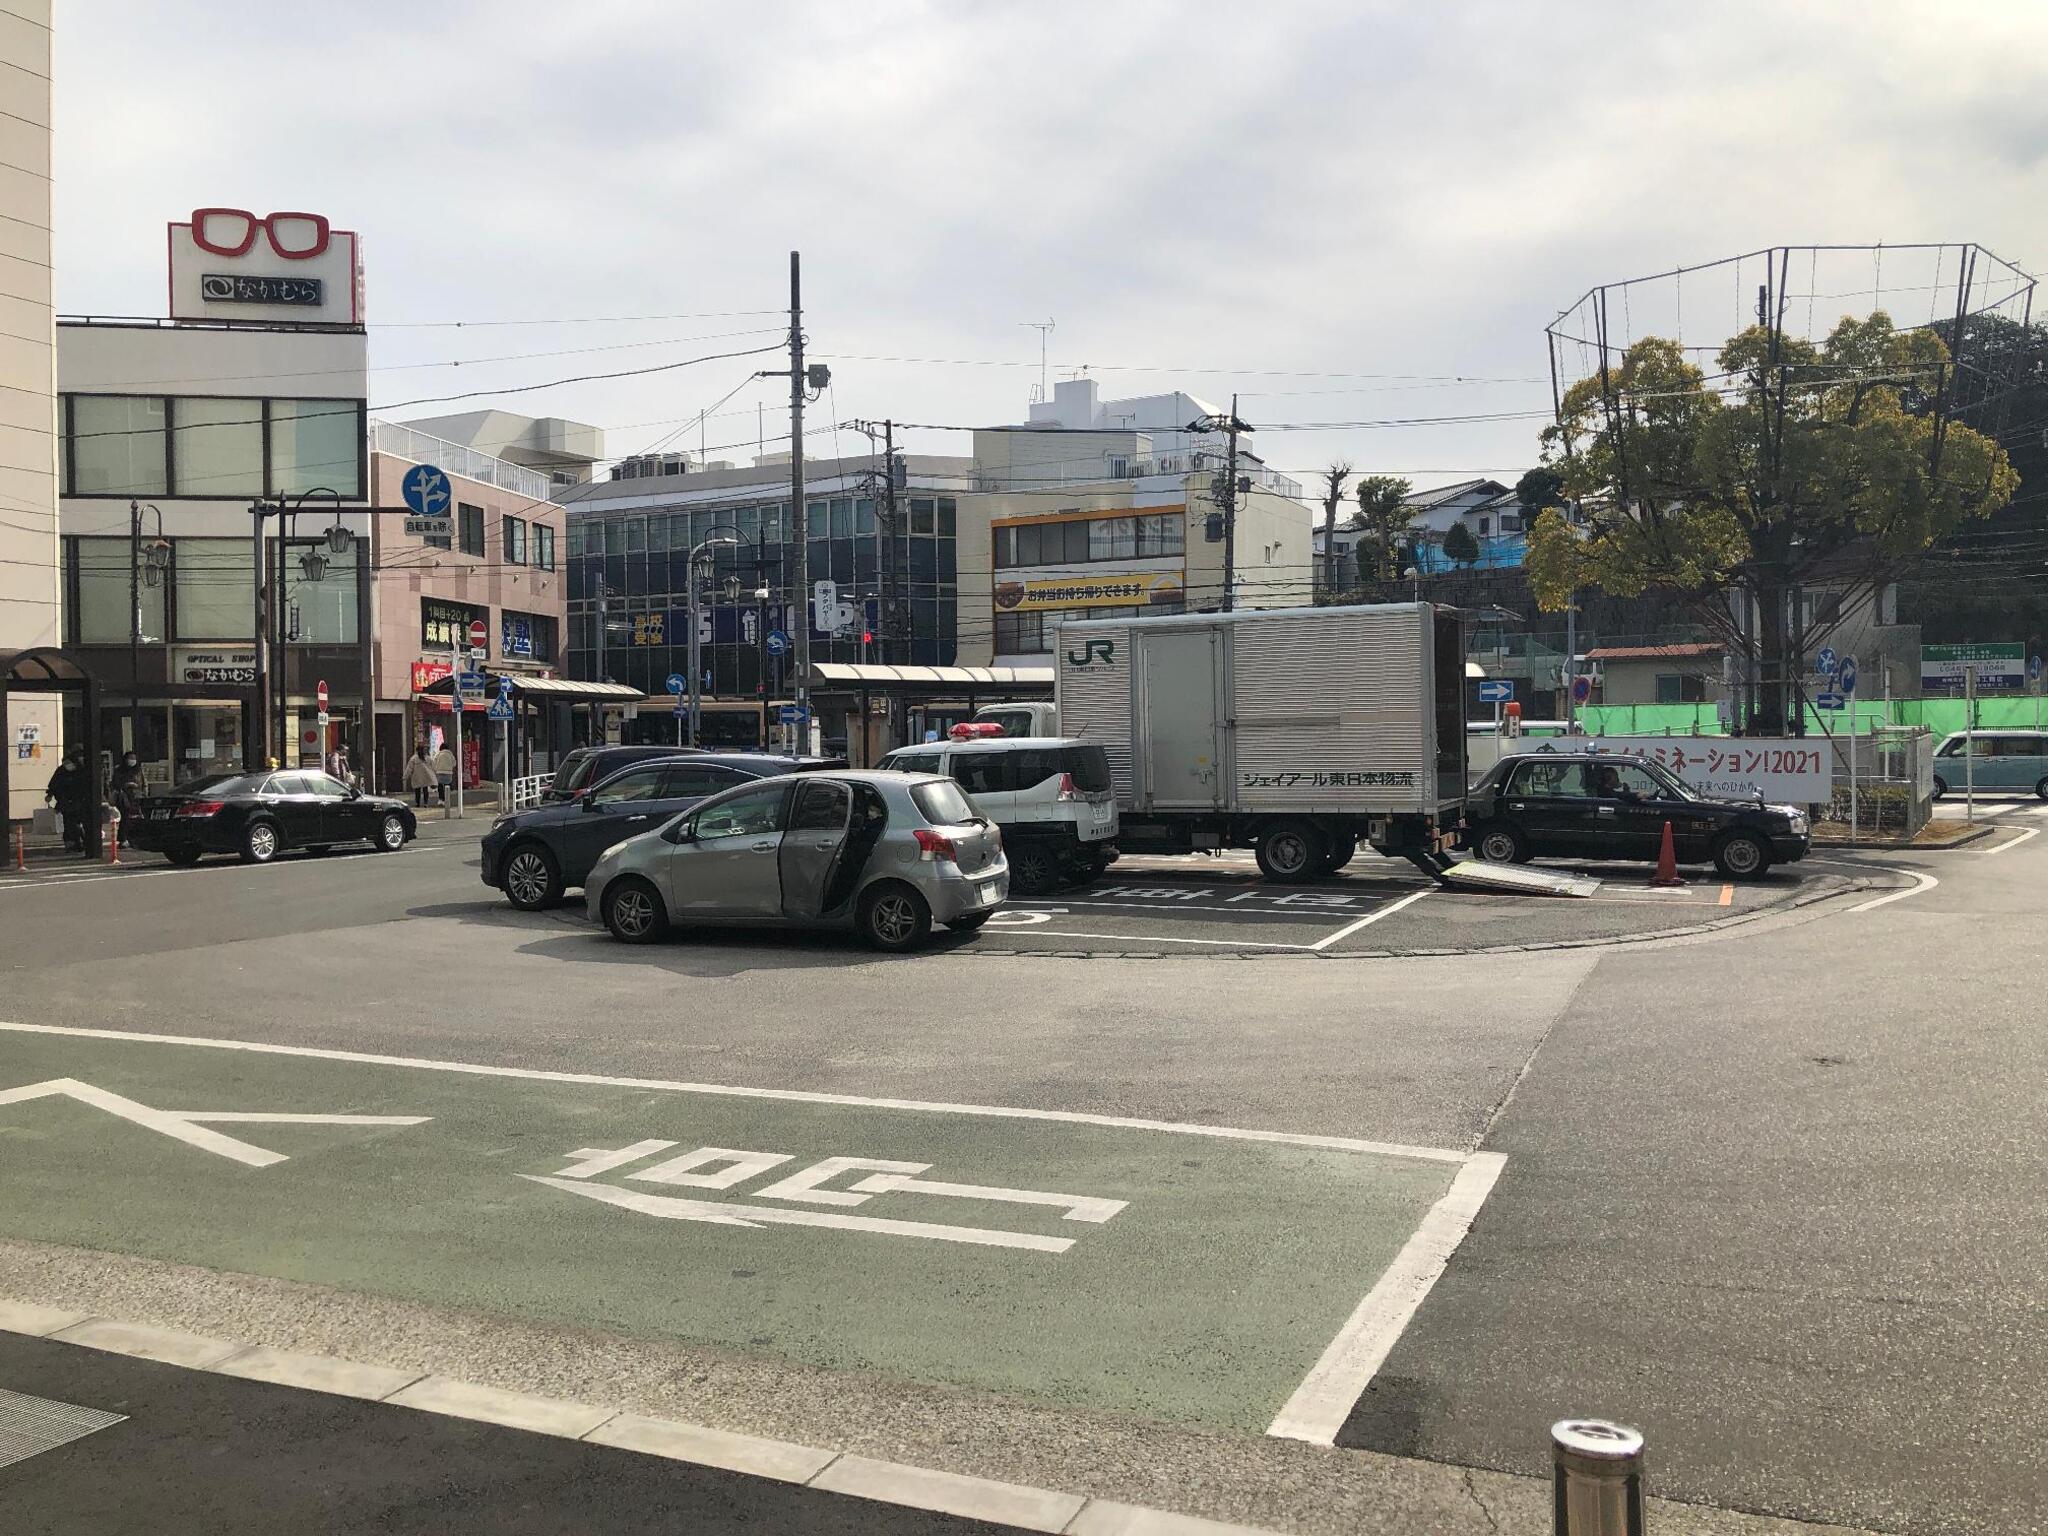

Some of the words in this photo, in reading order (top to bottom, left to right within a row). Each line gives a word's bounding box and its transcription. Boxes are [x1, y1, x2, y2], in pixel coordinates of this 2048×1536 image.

[237, 279, 316, 301] なかむら
[187, 655, 224, 663] OPTICAL
[231, 655, 256, 663] SHOP
[1068, 640, 1114, 666] JR
[206, 669, 255, 681] なかむら
[1243, 772, 1414, 787] ジェイアール東日本物流
